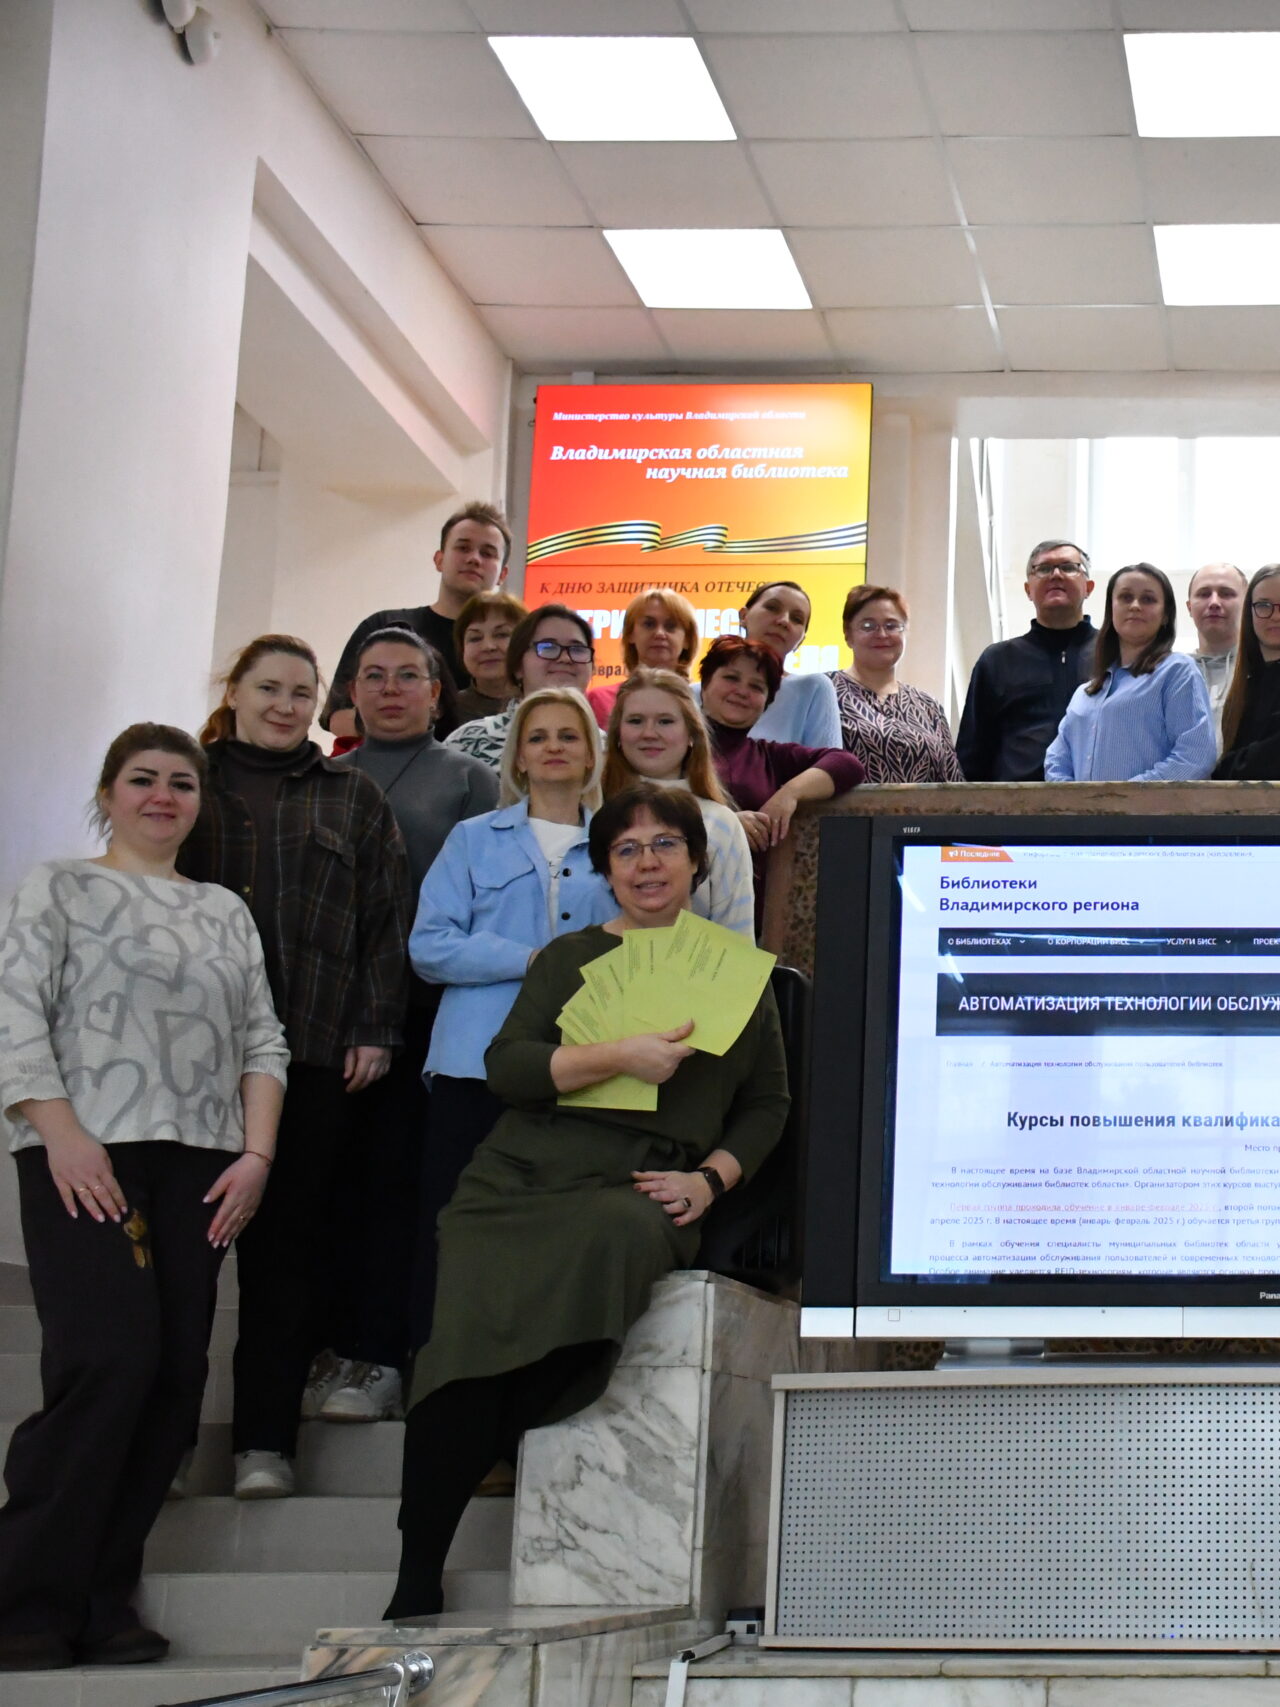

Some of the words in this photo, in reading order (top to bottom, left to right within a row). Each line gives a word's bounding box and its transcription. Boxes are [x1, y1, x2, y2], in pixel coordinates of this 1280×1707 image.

[552, 411, 631, 421] Министерство
[632, 411, 684, 422] культуры
[550, 445, 692, 463] Владимирская
[696, 445, 804, 459] областная
[646, 465, 727, 482] научная
[732, 464, 849, 478] библиотека
[539, 582, 551, 594] К
[553, 582, 592, 596] ДНЮ
[960, 849, 1001, 859] Последние
[940, 876, 1037, 889] Библиотеки
[939, 898, 1068, 913] Владимирского
[1073, 900, 1140, 914] региона
[958, 996, 1100, 1013] АВТОМАТИЗАЦИЯ
[1107, 996, 1212, 1011] ТЕХНОЛОГИИ
[1007, 1111, 1064, 1130] Курсы
[1070, 1115, 1176, 1127] повышения
[961, 1168, 1006, 1176] настоящее
[1010, 1168, 1036, 1176] время
[1053, 1166, 1073, 1174] базе
[1077, 1166, 1139, 1176] Владимирской
[1142, 1166, 1186, 1174] областной
[1190, 1167, 1226, 1176] научной
[1229, 1166, 1279, 1174] библиотеки
[982, 1180, 1042, 1190] обслуживания
[1044, 1180, 1089, 1188] библиотек
[1134, 1181, 1200, 1190] Организатором
[1223, 1182, 1252, 1190] курсов
[1224, 1203, 1254, 1212] второй
[930, 1218, 960, 1226] апреле
[963, 1217, 984, 1225] 2025
[995, 1217, 1001, 1225] В
[1003, 1218, 1048, 1226] настоящее
[1050, 1218, 1076, 1226] время
[1153, 1217, 1174, 1225] 2025
[1187, 1217, 1230, 1227] обучается
[1232, 1218, 1259, 1227] третья
[962, 1241, 992, 1249] рамках
[1000, 1240, 1040, 1249] обучения
[1047, 1241, 1102, 1249] специалисты
[1109, 1241, 1177, 1249] муниципальных
[929, 1255, 969, 1263] процесса
[972, 1255, 1037, 1263] автоматизации
[1040, 1253, 1101, 1263] обслуживания
[1105, 1253, 1168, 1262] пользователей
[1180, 1255, 1237, 1263] современных
